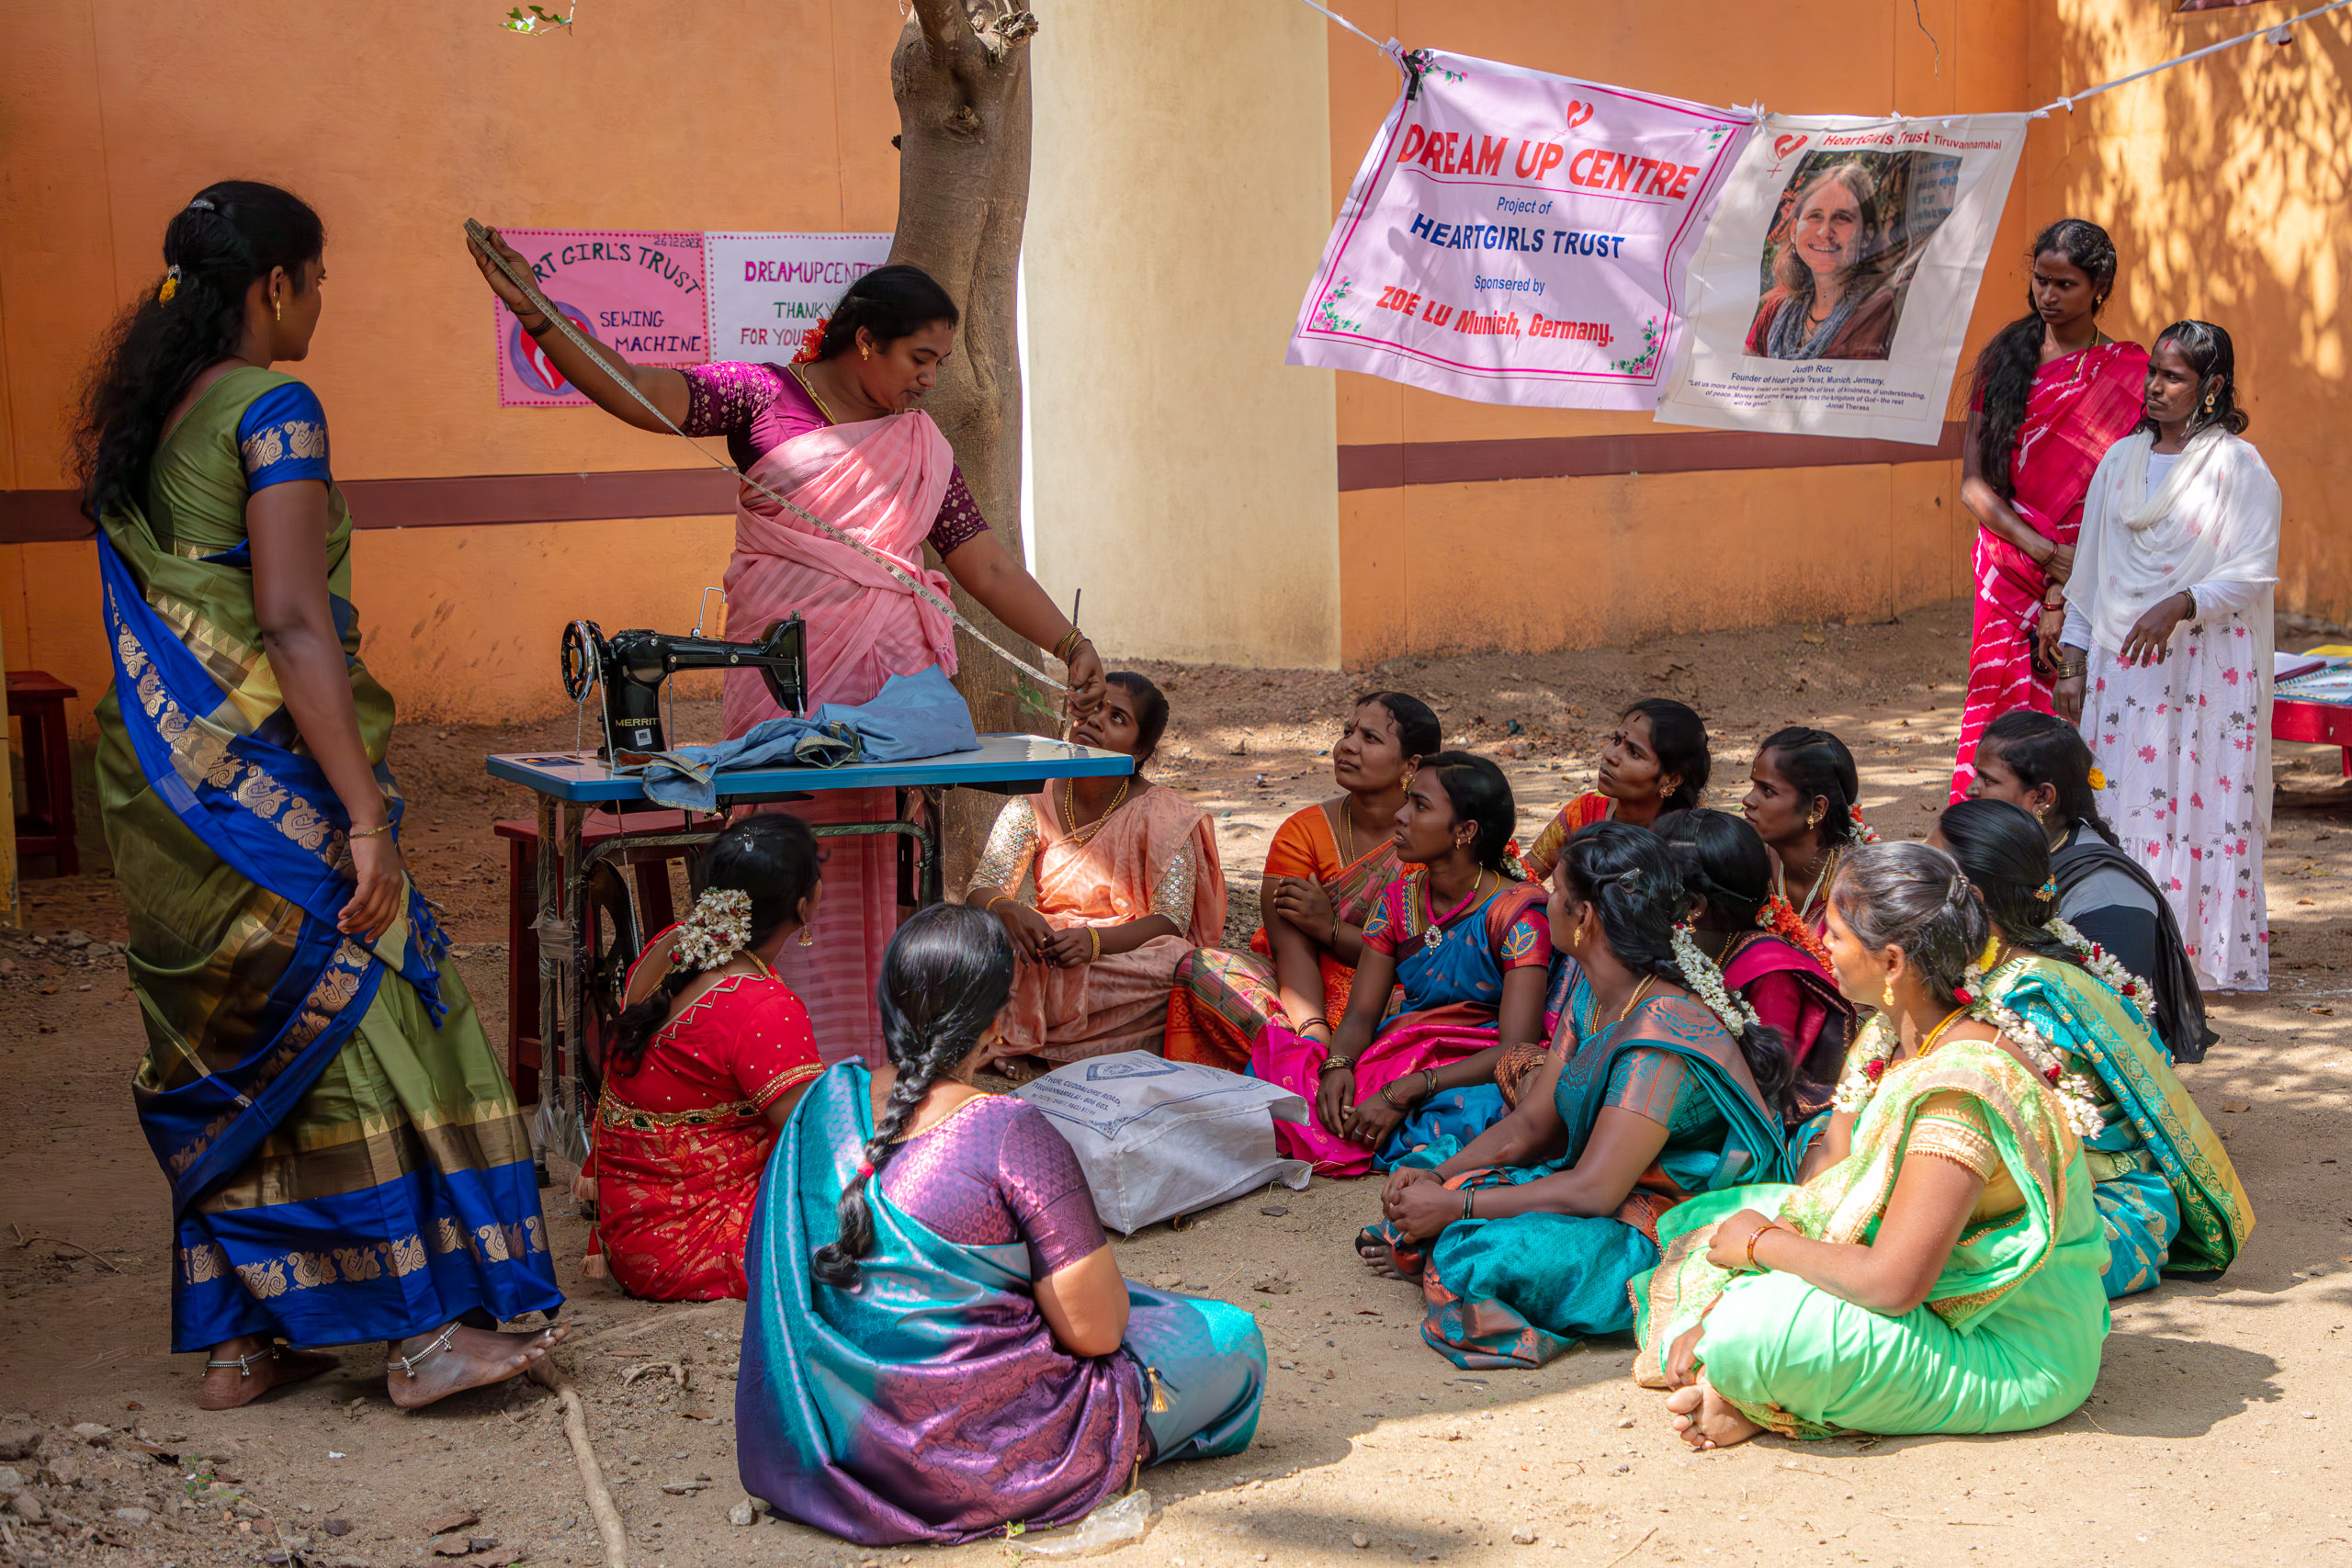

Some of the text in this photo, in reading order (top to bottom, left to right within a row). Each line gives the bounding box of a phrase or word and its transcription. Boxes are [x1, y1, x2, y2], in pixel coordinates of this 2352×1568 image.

[1823, 131, 1895, 146] HeartGirls
[1933, 134, 2003, 151] Tiruvannamalai
[1396, 123, 1701, 201] DREAM UP CENTRE
[1497, 196, 1554, 215] Project of
[654, 237, 667, 246] 26
[1410, 212, 1625, 259] HEARTGIRLS TRUST
[639, 246, 702, 294] TRUST
[744, 261, 886, 284] DREAMUPCENTE
[1474, 276, 1545, 297] Sponsered by
[599, 310, 665, 328] SEWING
[1376, 285, 1615, 347] ZOE LU Munich, Germany.
[615, 336, 702, 352] MACHINE
[740, 328, 768, 345] FOR
[1731, 372, 1762, 383] Founder
[1771, 376, 1790, 384] Heart
[1790, 376, 1805, 385] girls
[1064, 1080, 1102, 1097] CUDDALORE
[1102, 1092, 1121, 1107] ROAD,
[1083, 1097, 1096, 1105] 606
[1095, 1102, 1108, 1111] 603.
